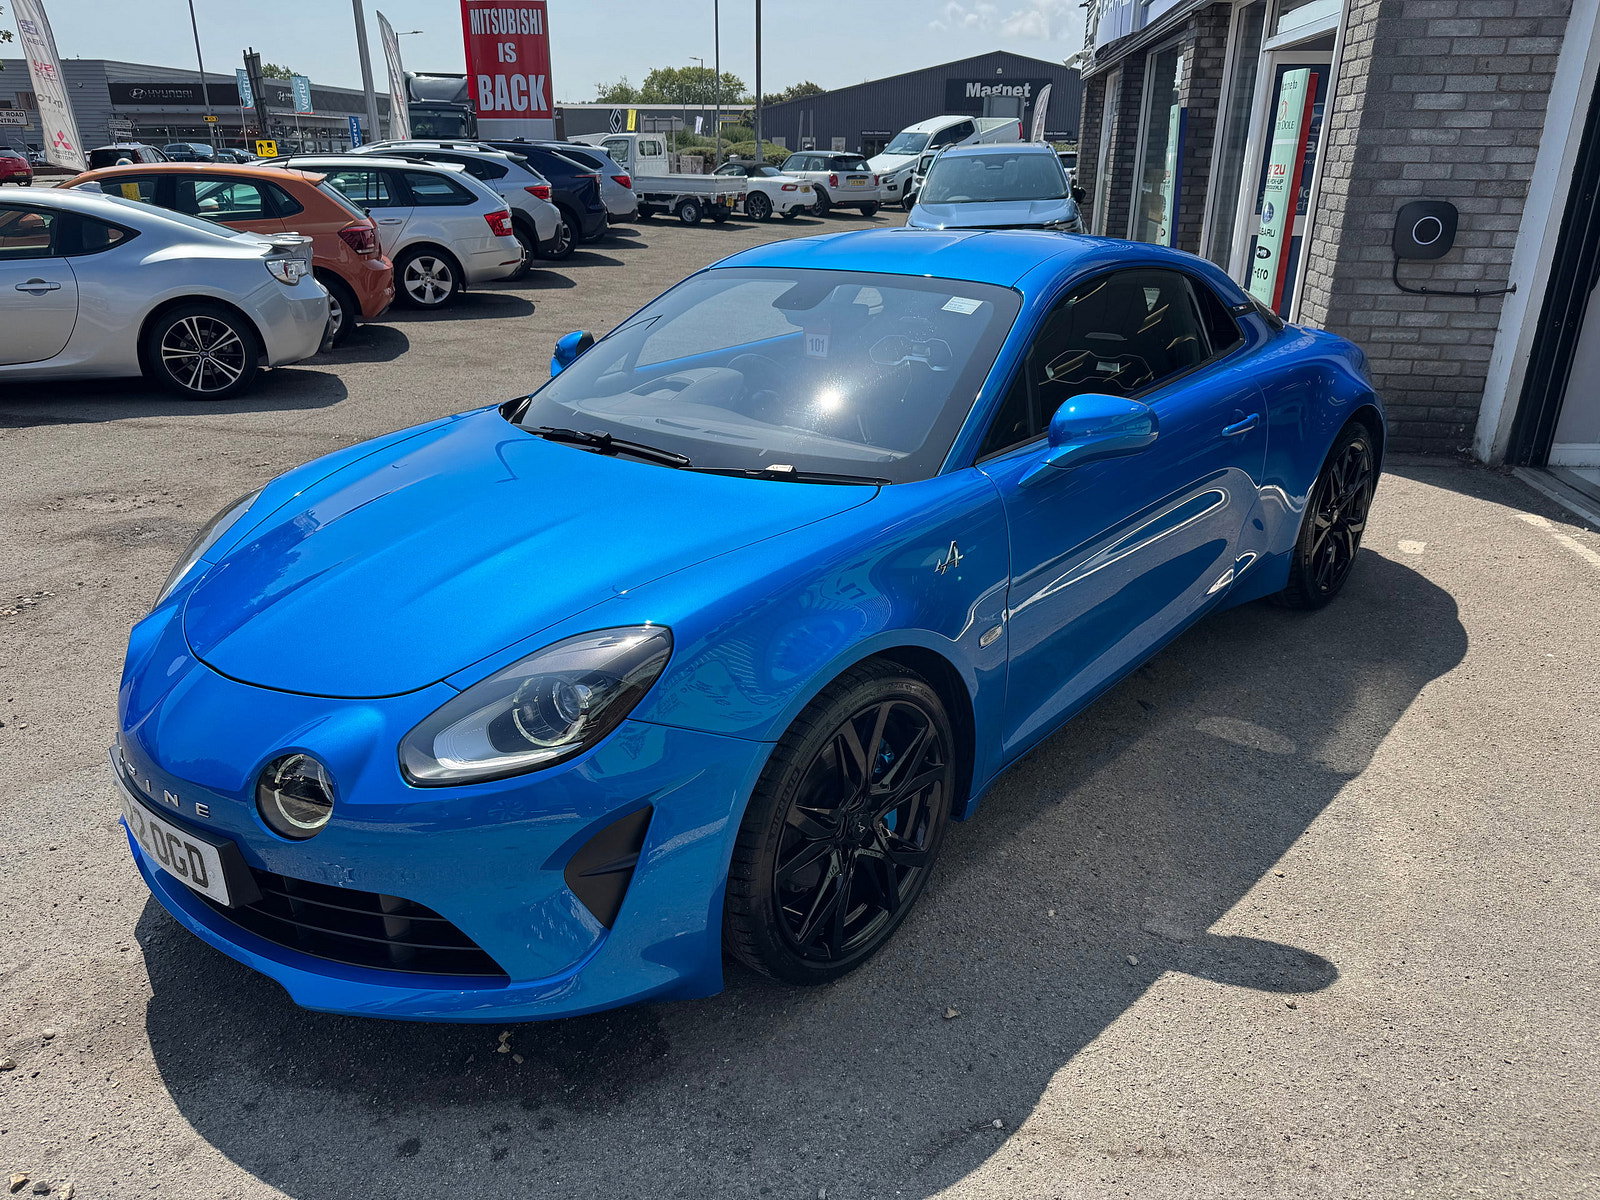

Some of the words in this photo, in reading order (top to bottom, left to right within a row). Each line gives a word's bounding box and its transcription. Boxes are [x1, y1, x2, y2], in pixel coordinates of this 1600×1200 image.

[470, 8, 543, 34] MITSUBISHI
[497, 42, 517, 63] IS
[148, 89, 193, 98] HYUNDAI
[477, 73, 548, 111] BACK
[965, 82, 1031, 98] Magnet
[809, 338, 825, 352] 101
